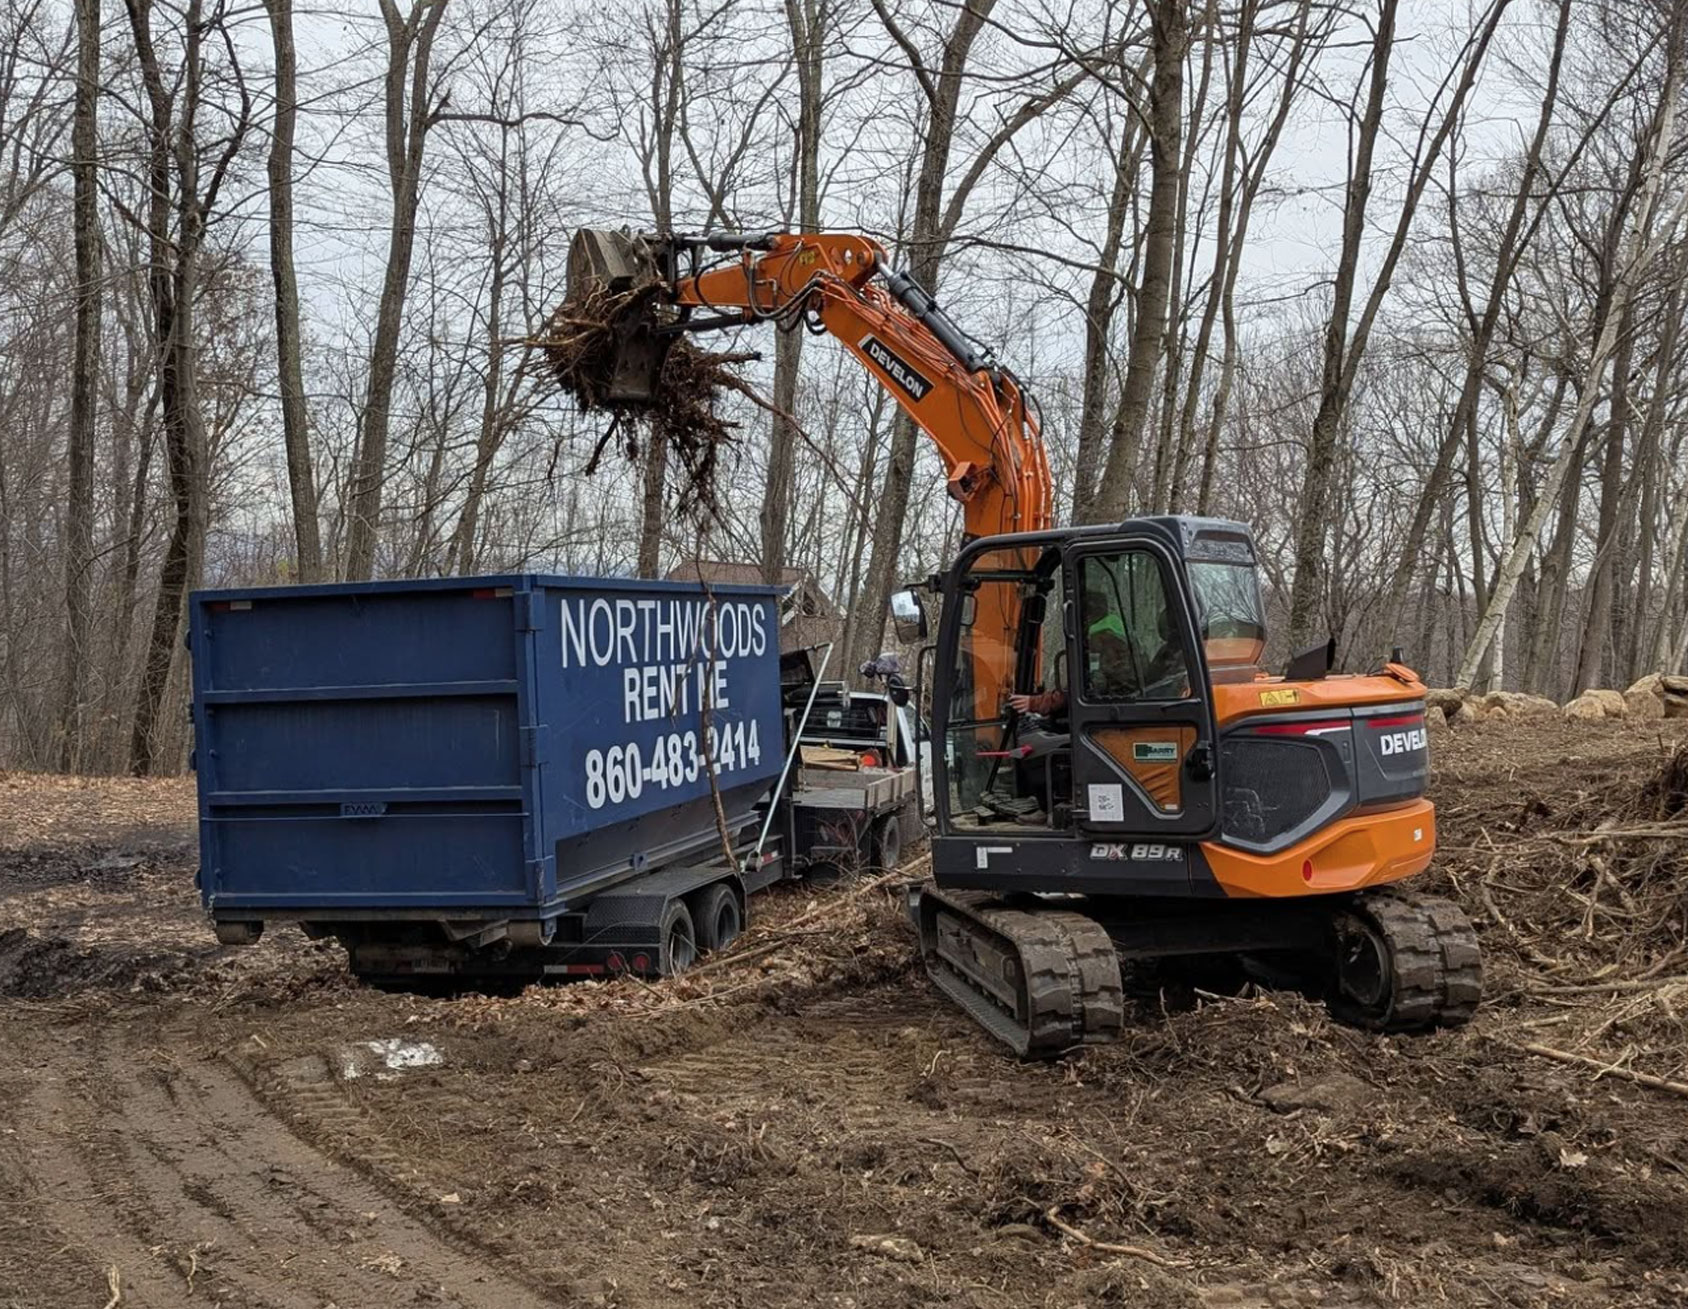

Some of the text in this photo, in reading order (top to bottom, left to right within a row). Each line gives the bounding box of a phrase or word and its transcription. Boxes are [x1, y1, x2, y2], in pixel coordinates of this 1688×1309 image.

[869, 343, 924, 398] DEVELON
[561, 598, 767, 668] NORTHWOODS
[624, 663, 692, 723] RENT
[585, 718, 761, 809] 860-483-2414
[1090, 843, 1128, 860] DX
